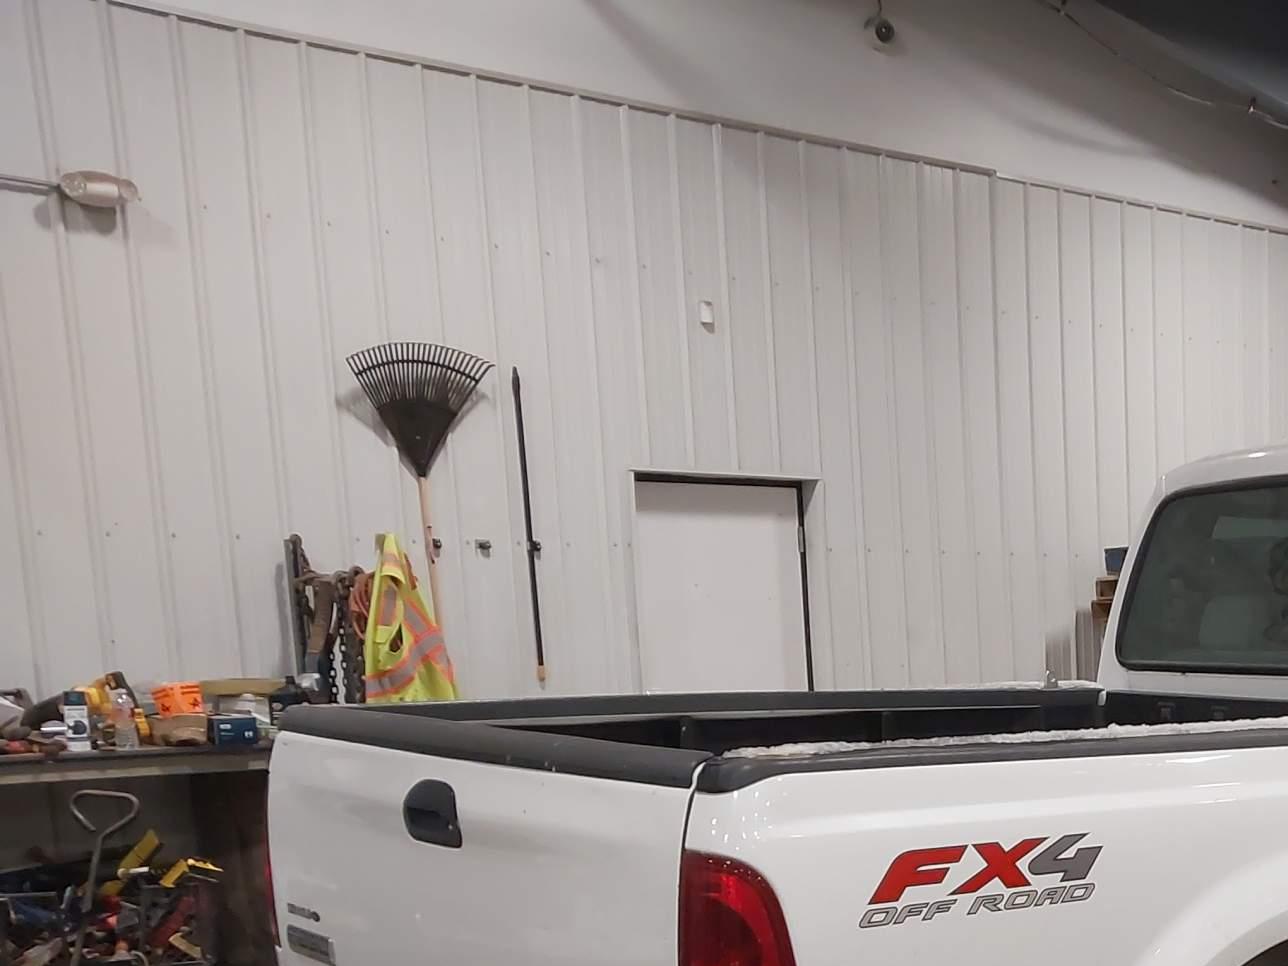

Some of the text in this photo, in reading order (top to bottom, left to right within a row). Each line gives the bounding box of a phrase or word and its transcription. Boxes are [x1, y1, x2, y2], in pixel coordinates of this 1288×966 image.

[868, 832, 1104, 905] FX4
[858, 883, 1096, 929] OFF ROAD
